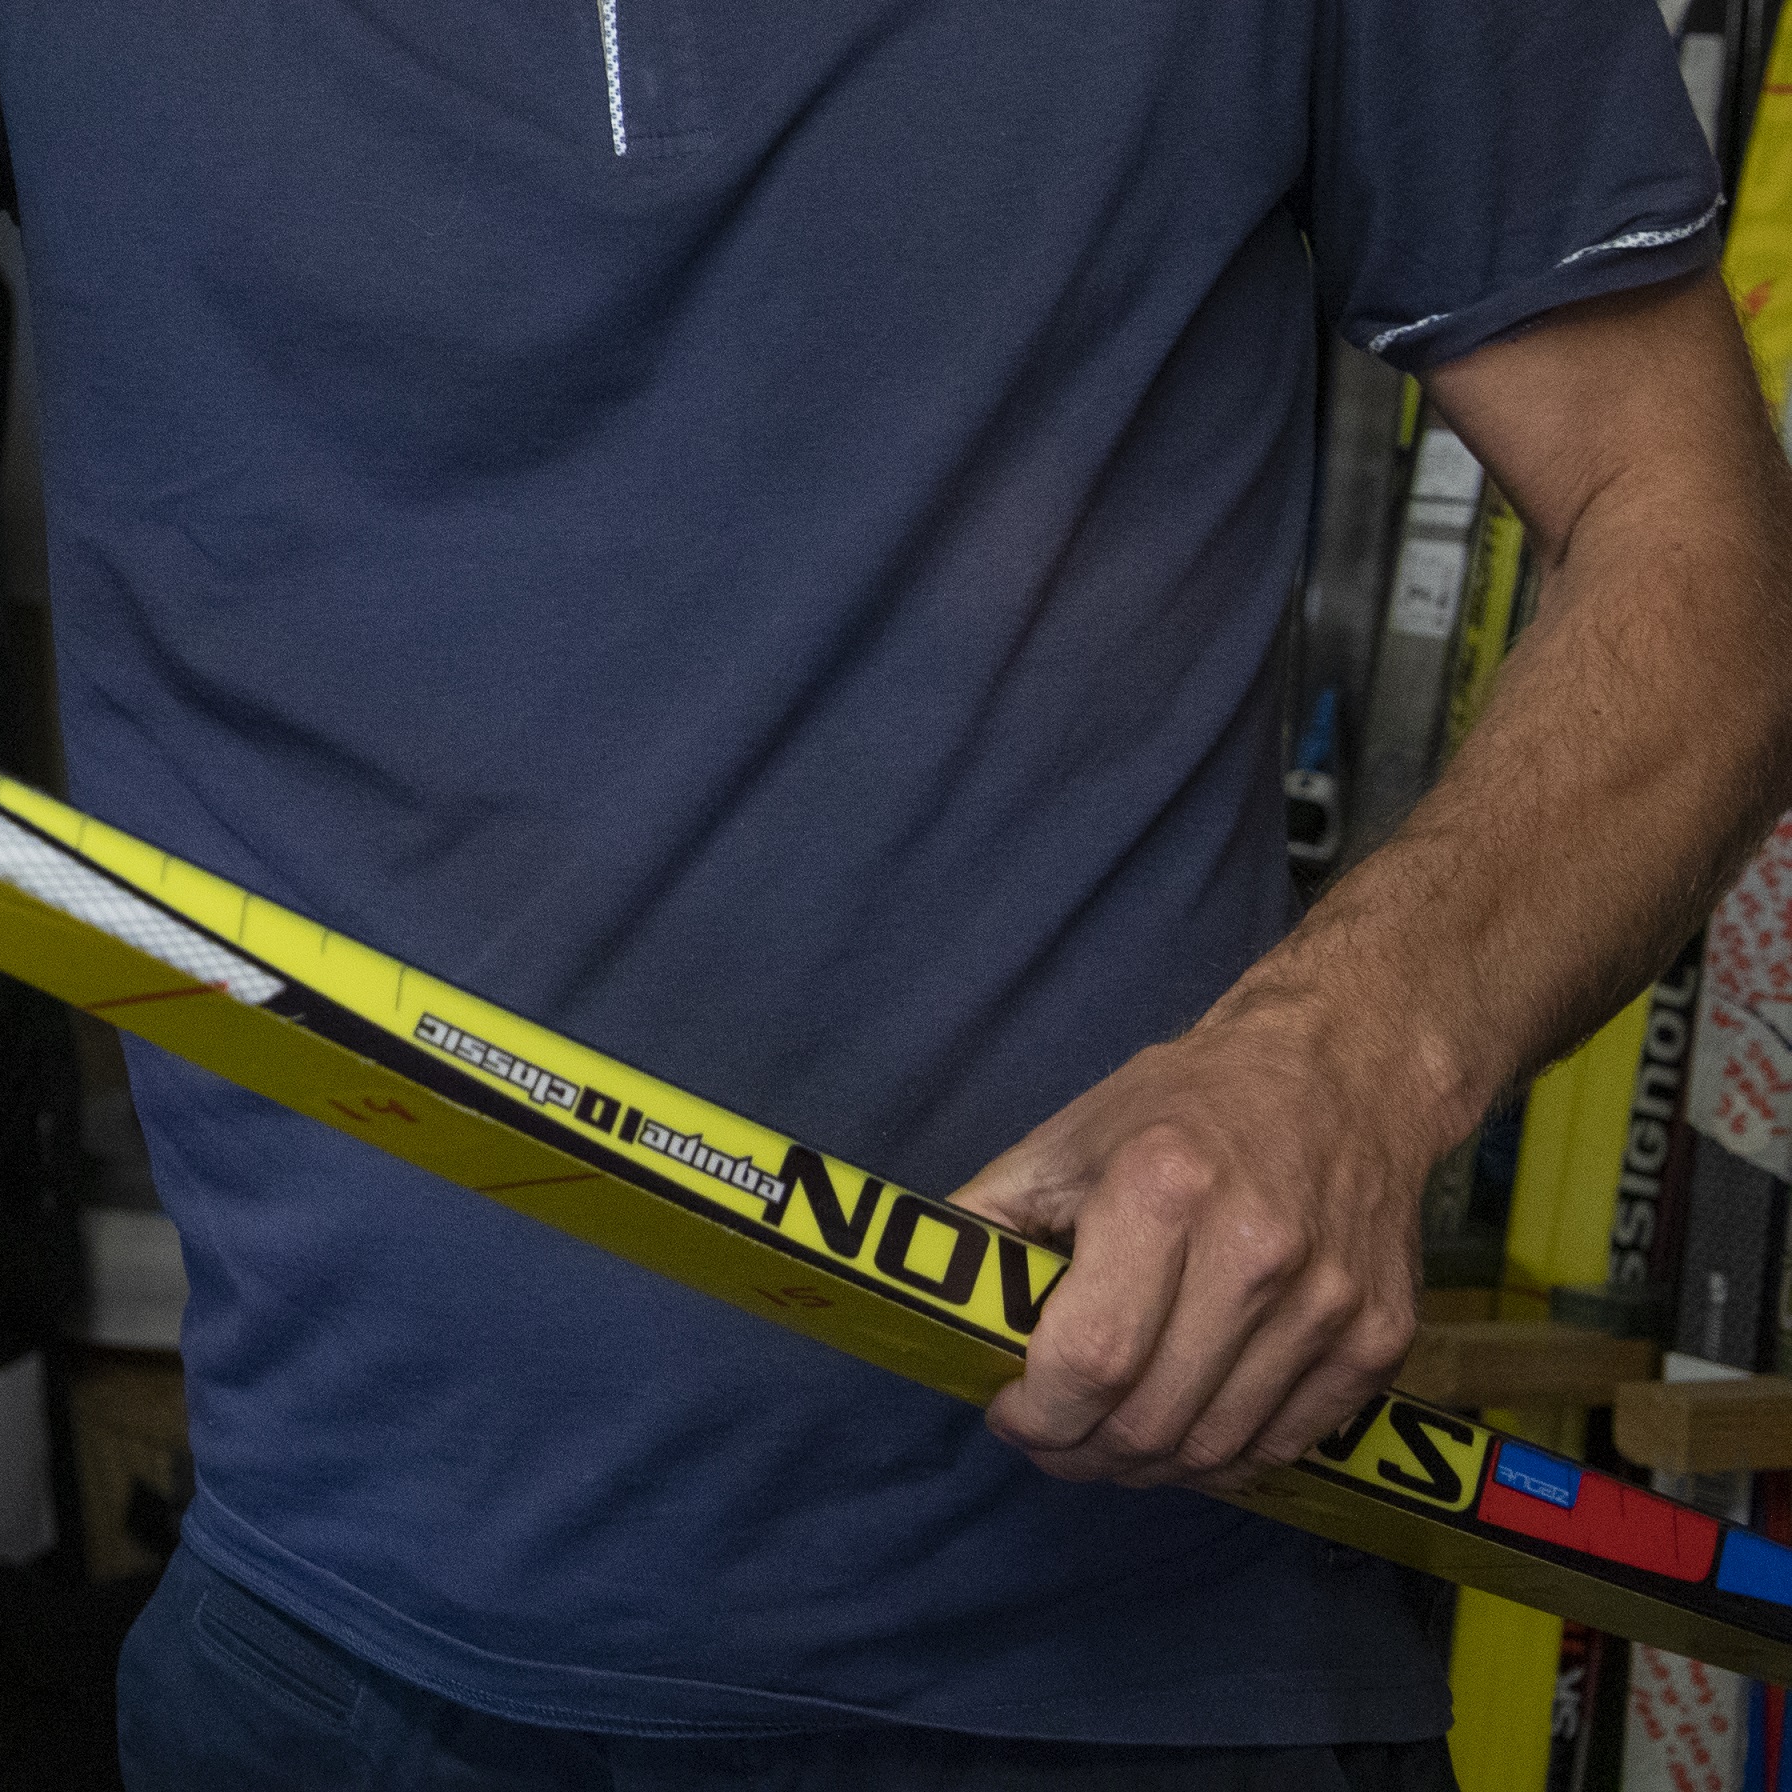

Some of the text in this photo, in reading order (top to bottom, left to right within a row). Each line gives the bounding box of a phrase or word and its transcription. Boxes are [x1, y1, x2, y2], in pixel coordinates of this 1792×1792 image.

[412, 1011, 579, 1111] classic
[575, 1085, 643, 1145] 10
[640, 1119, 787, 1204] equipe
